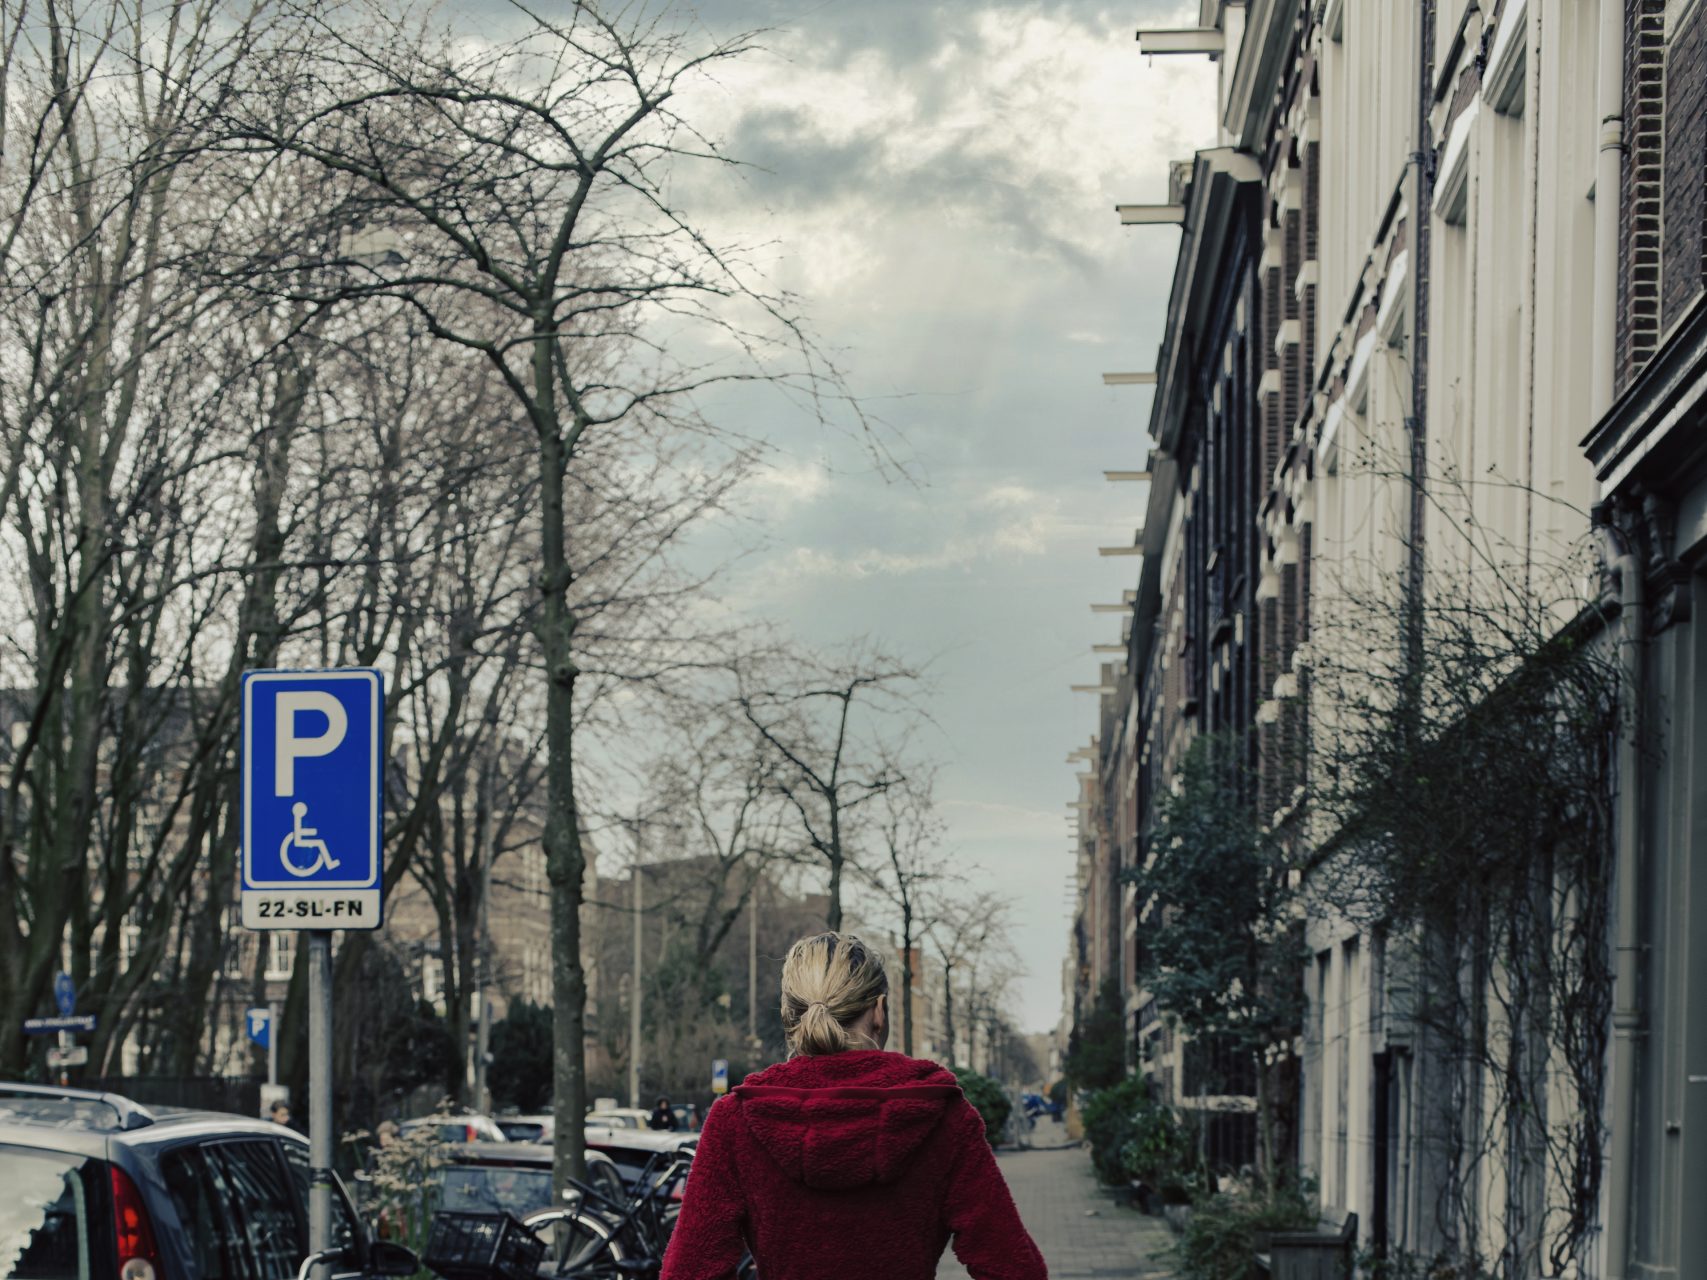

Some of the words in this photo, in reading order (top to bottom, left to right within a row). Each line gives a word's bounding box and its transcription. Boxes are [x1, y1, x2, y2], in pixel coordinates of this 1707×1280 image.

[275, 691, 348, 797] P
[259, 900, 362, 917] 22-SL-FN
[252, 1018, 265, 1037] P
